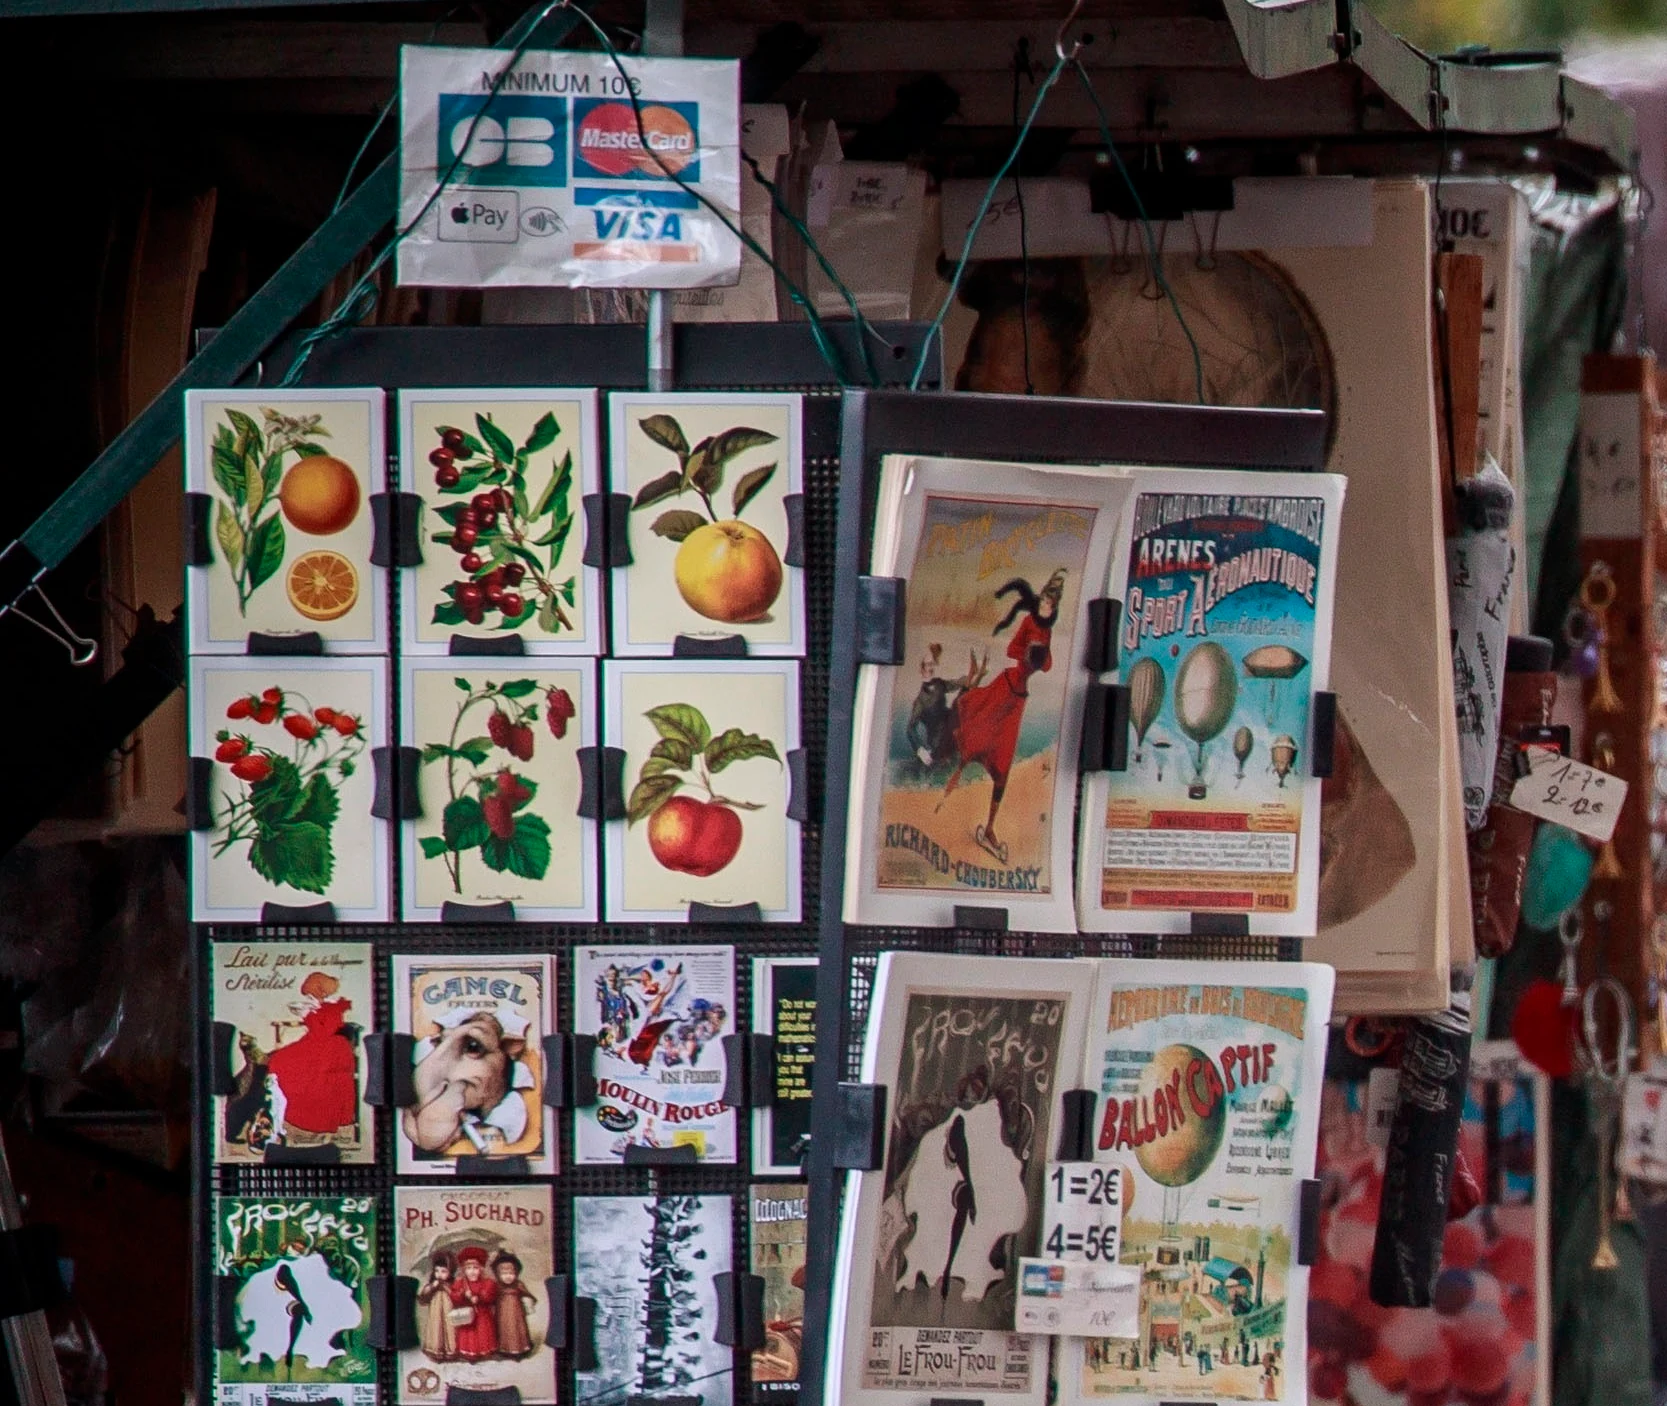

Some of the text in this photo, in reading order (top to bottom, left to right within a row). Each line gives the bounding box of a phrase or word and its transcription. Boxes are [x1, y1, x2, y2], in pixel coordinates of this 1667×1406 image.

[481, 72, 590, 94] MINIMUM
[473, 204, 509, 231] Pay
[593, 209, 682, 242] VISA
[1136, 537, 1216, 580] ARENES
[1125, 590, 1188, 651] SPORT
[224, 946, 268, 968] Lait
[422, 975, 528, 1006] CAMEL
[1098, 1067, 1185, 1151] BALLON
[1186, 1043, 1276, 1118] CAPTIF
[1051, 1166, 1121, 1206] 1=2€
[406, 1202, 545, 1228] PH. SUCHARD
[1046, 1223, 1118, 1263] 4=5€
